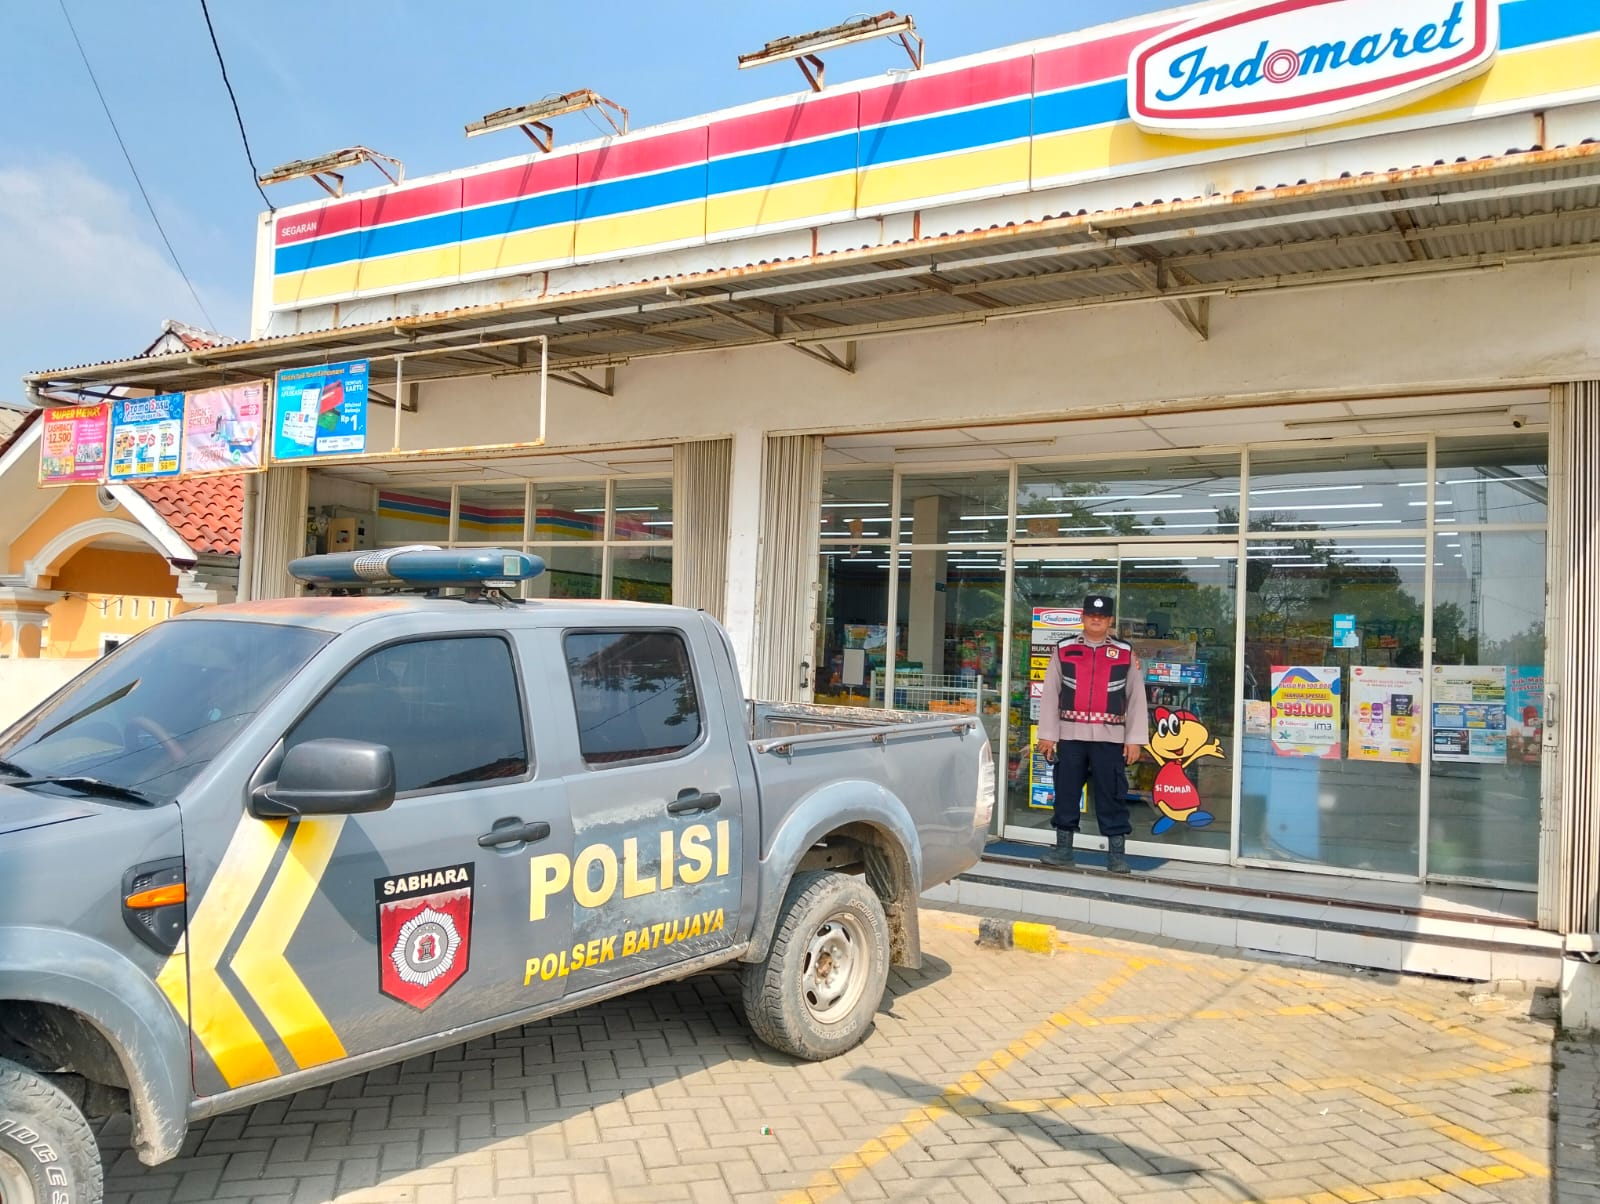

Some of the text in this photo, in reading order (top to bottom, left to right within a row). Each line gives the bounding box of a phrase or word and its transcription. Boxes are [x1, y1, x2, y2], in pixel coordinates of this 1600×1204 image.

[1155, 1, 1464, 102] Indomaret
[281, 221, 317, 237] SEGARAN
[51, 408, 75, 420] SUPER
[340, 415, 350, 424] Rp
[47, 423, 74, 433] CASHBACK
[49, 433, 72, 444] 12.500
[1284, 702, 1333, 717] 99.000
[1163, 784, 1191, 794] DOMAR
[528, 819, 730, 922] POLISI
[383, 866, 469, 896] SABHARA
[523, 907, 725, 986] POLSEK BATUJAYA
